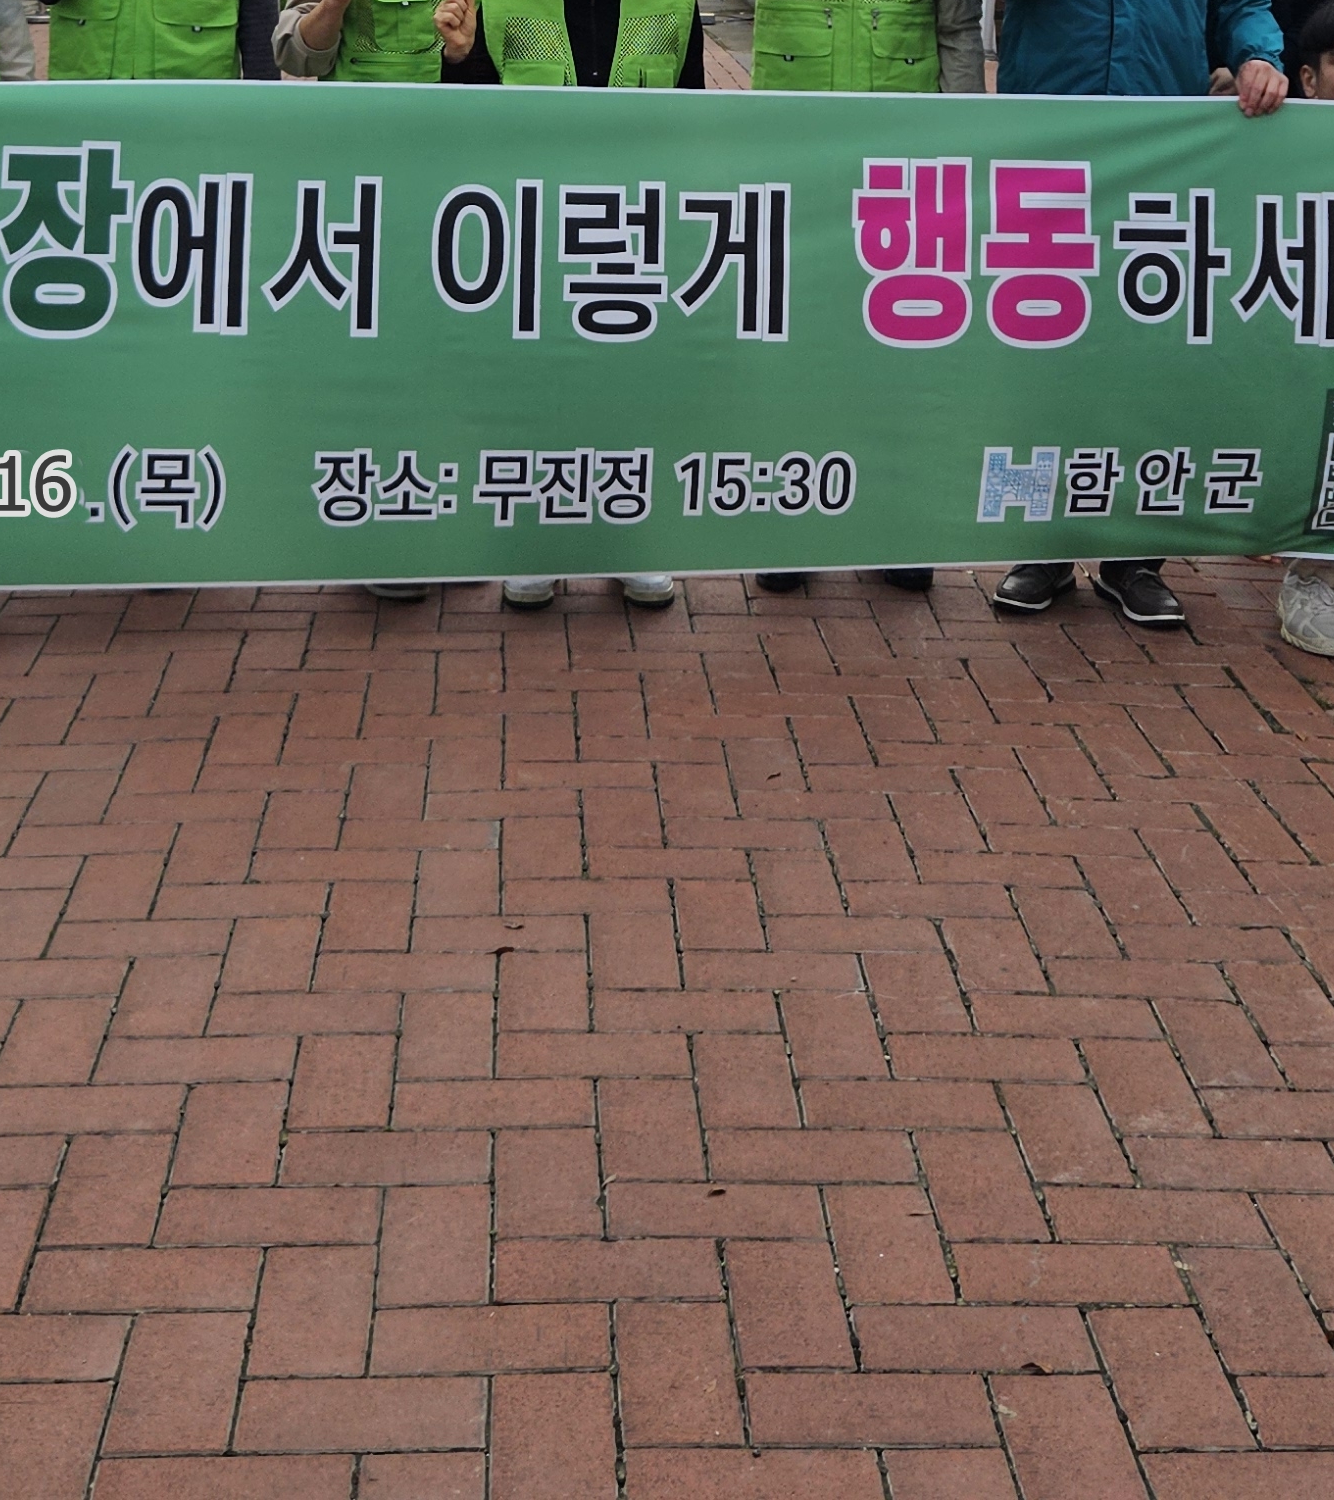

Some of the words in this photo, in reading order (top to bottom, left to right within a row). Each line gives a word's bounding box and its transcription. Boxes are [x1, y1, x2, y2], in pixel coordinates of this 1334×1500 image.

[431, 178, 792, 344] 이렇게
[312, 447, 459, 527] 장소:
[473, 447, 654, 527] 무진정
[674, 450, 858, 517] 15:30
